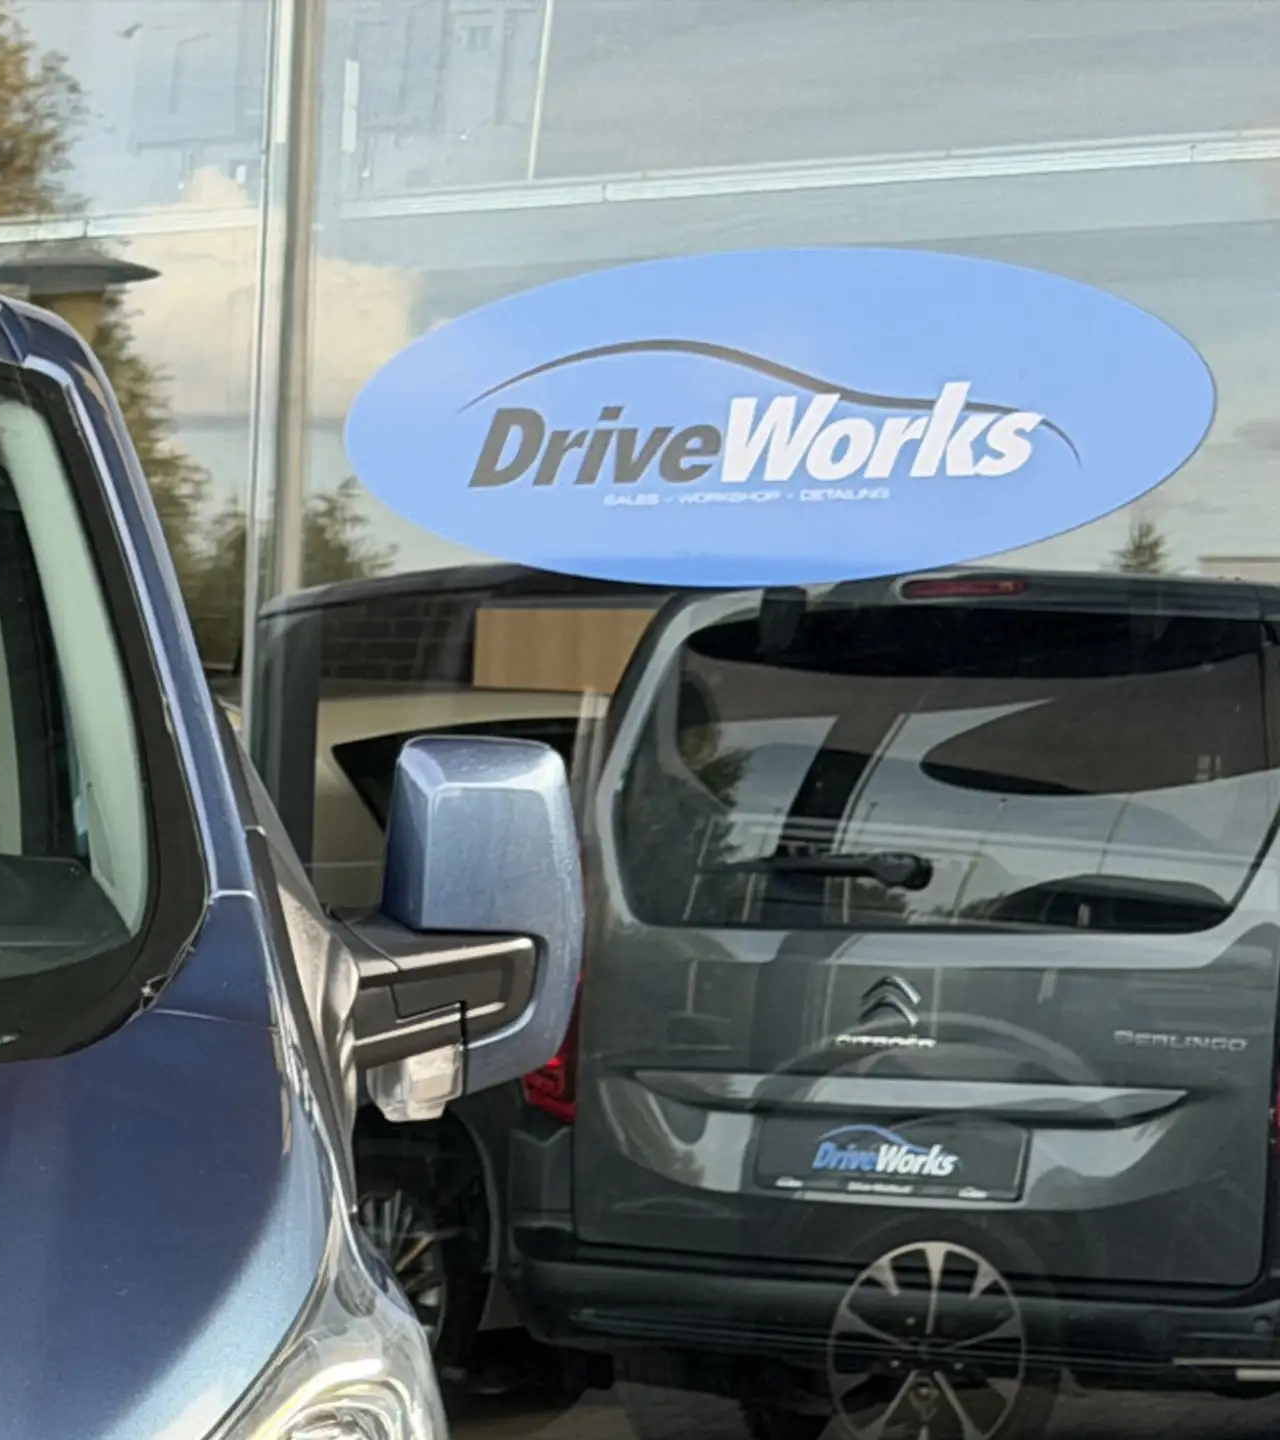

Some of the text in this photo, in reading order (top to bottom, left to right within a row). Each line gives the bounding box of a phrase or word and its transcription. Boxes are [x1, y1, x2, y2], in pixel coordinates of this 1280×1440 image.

[467, 380, 1044, 488] DriveWorks
[603, 488, 889, 505] SALES WORKSHOP DETAILING
[812, 1142, 959, 1177] DriveWorks
